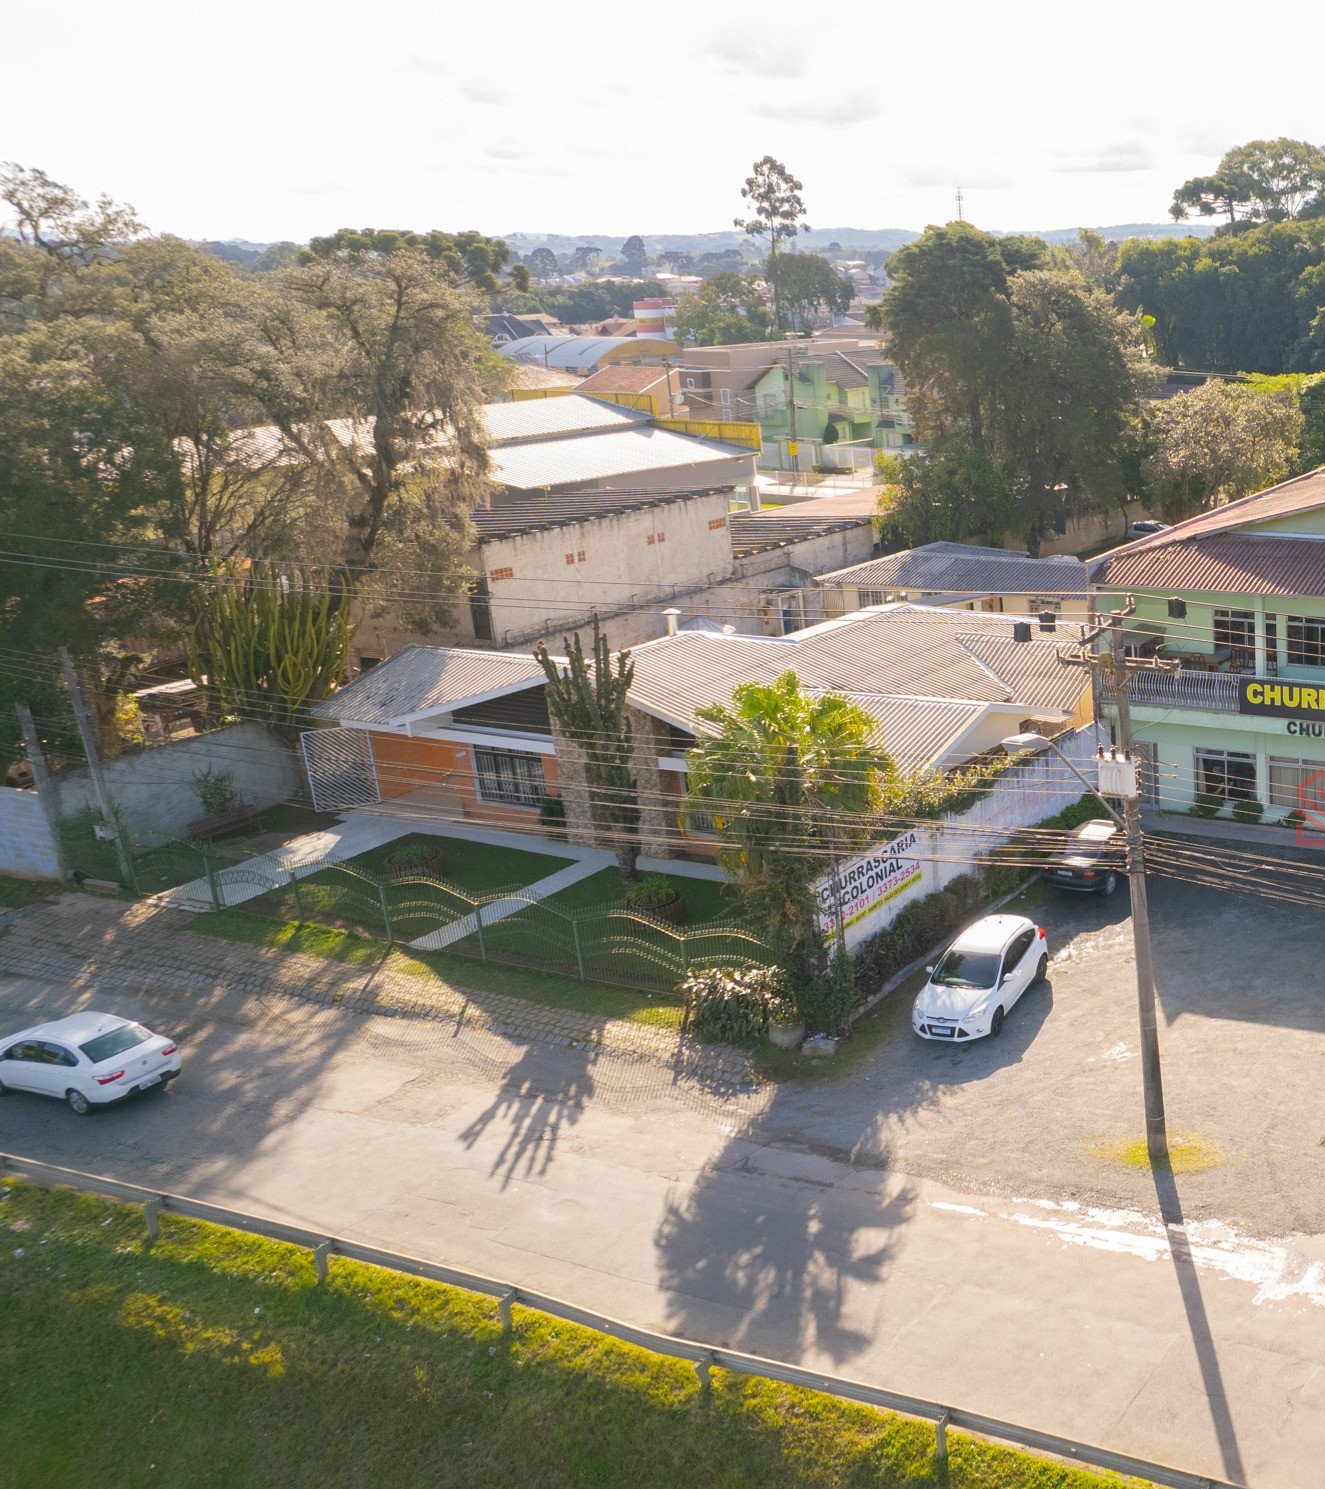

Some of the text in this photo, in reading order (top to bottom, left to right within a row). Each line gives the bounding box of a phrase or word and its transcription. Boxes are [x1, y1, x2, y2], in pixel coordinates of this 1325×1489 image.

[823, 894, 870, 934] 332-2101
[877, 861, 920, 897] 3373-2534
[843, 857, 903, 905] COLONIAL
